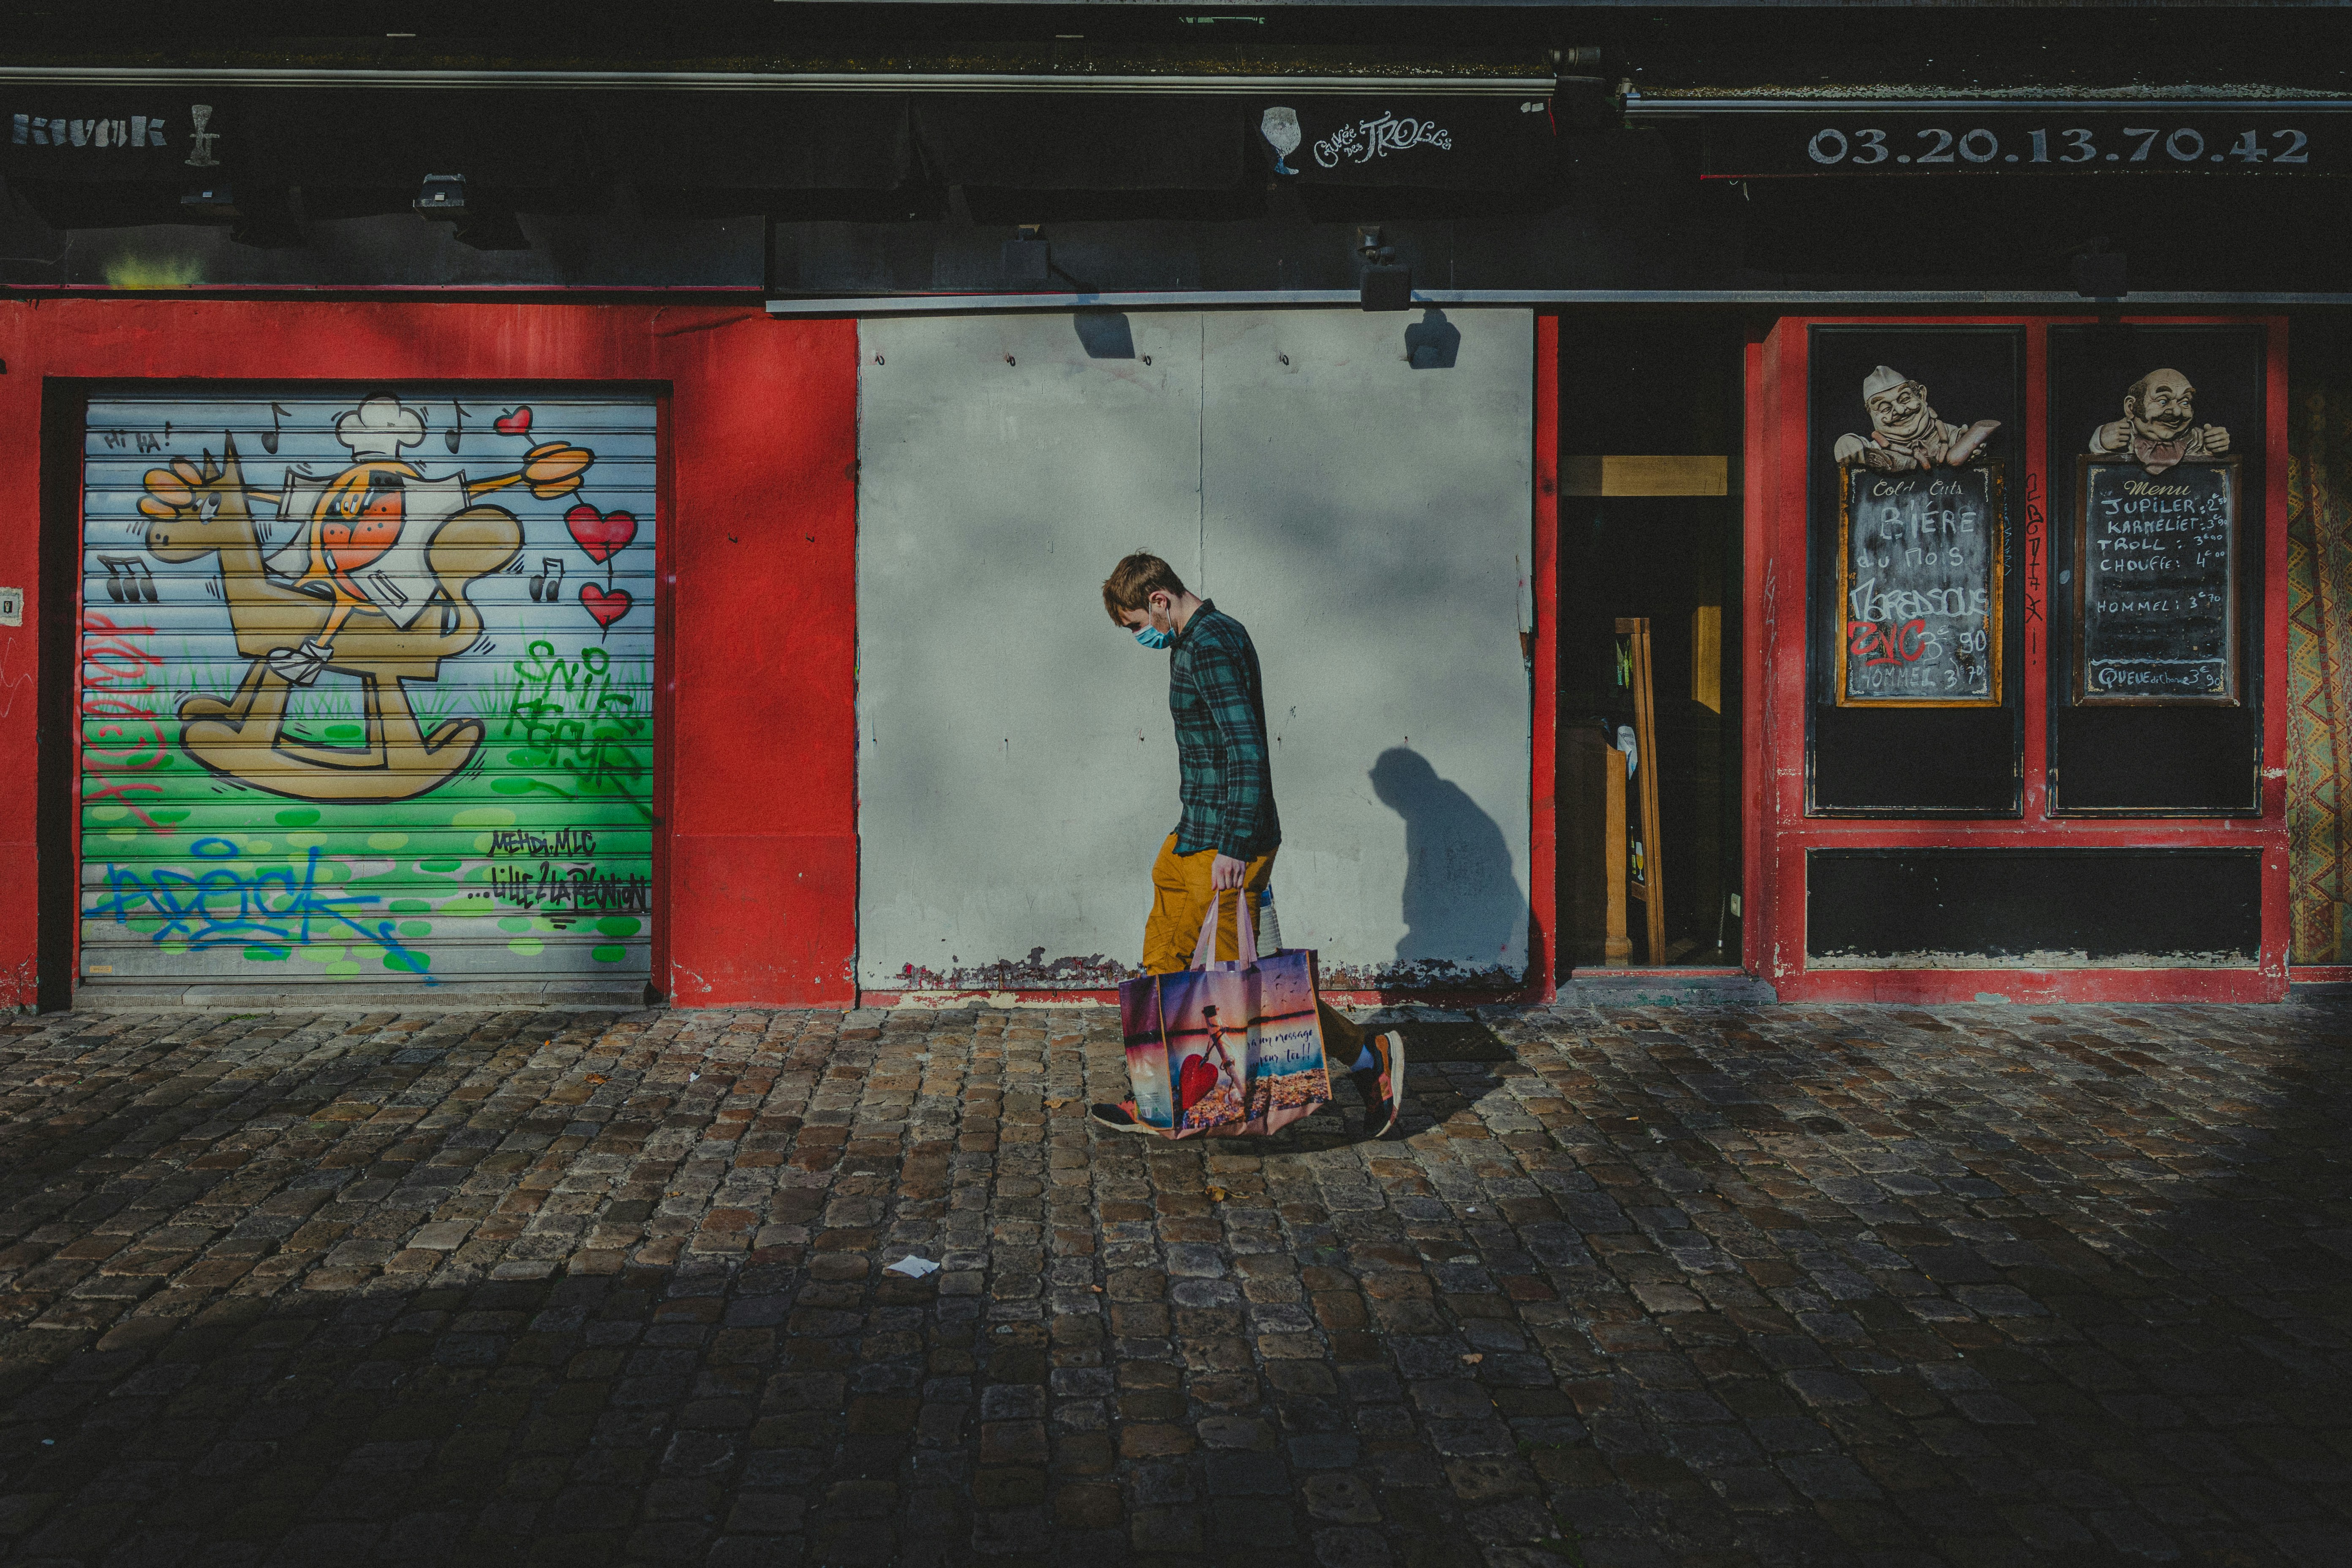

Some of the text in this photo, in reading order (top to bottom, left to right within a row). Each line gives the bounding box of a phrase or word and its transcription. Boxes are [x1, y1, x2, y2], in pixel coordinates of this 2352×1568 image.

[1808, 128, 2309, 164] 03.20.13.70.42
[2124, 480, 2191, 495] Menu
[1857, 548, 1890, 568] du
[1275, 1029, 1313, 1043] message
